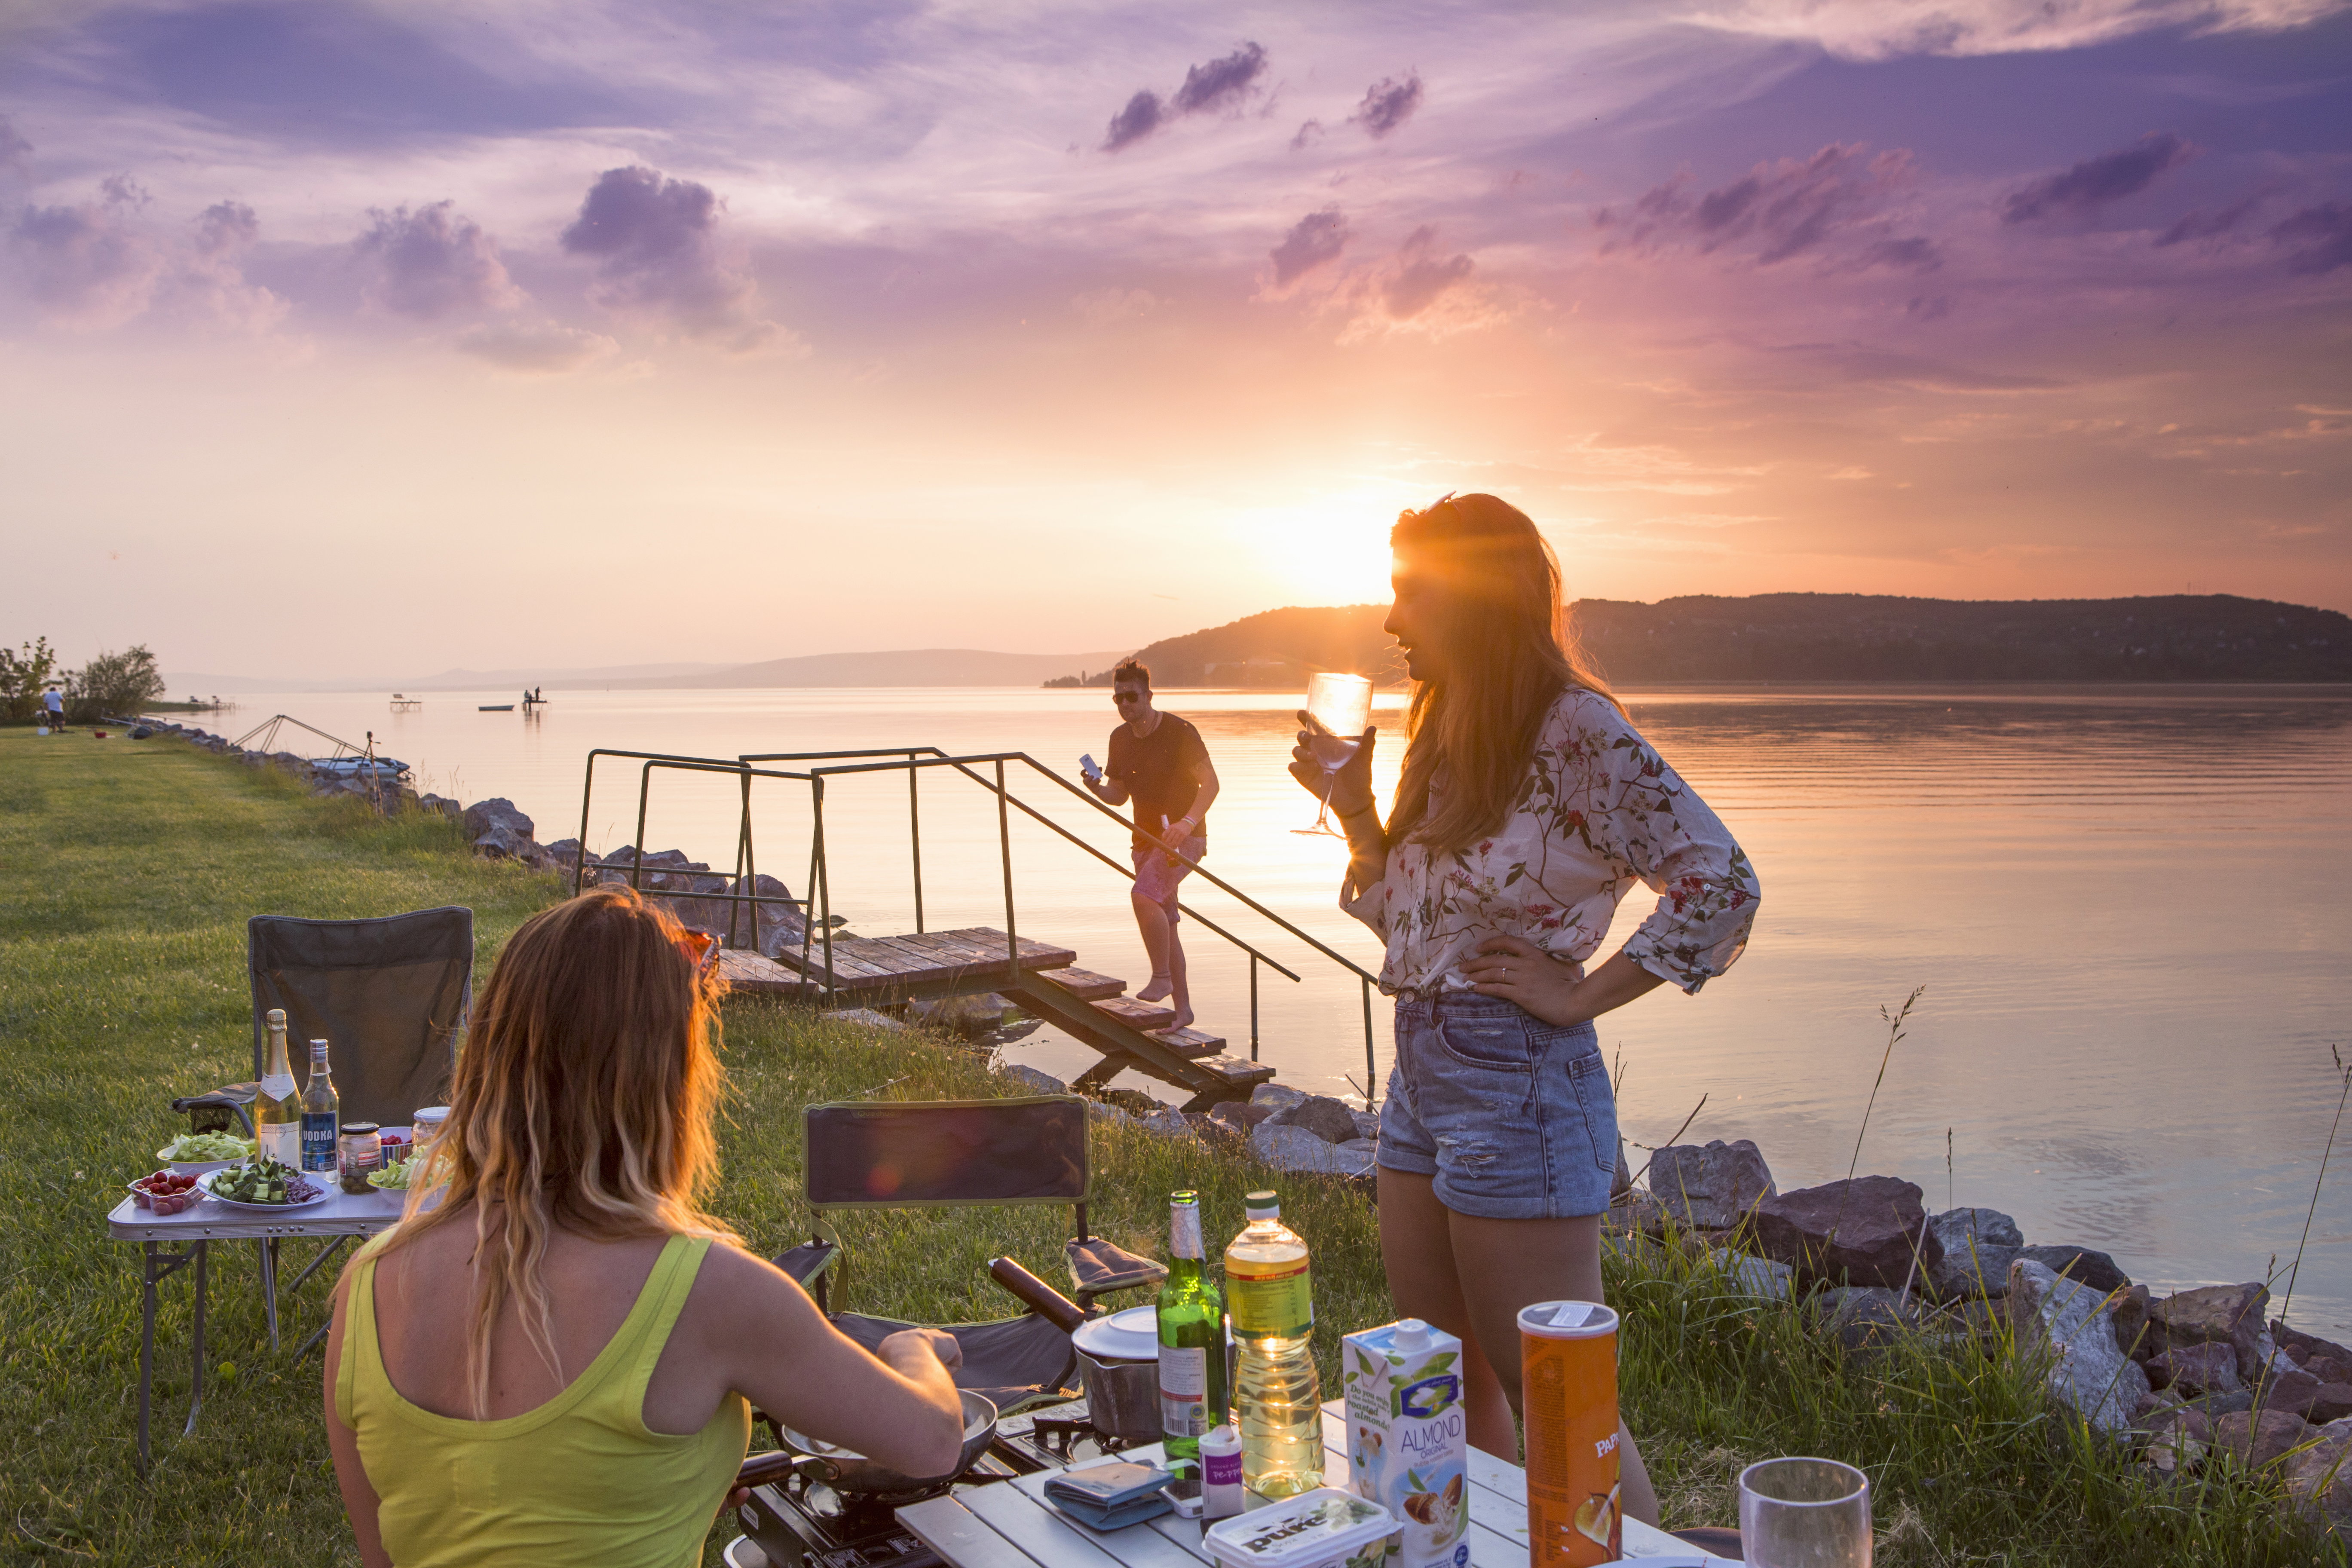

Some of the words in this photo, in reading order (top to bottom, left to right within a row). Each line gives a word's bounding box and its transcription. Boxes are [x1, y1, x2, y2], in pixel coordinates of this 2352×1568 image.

[303, 1130, 333, 1141] VODKA
[1351, 1384, 1361, 1394] Do
[1362, 1390, 1375, 1399] you
[1348, 1400, 1378, 1416] roasted
[1354, 1411, 1390, 1433] almonds?
[1401, 1415, 1461, 1453] ALMOND
[1421, 1442, 1448, 1459] ORIGINAL
[1241, 1515, 1328, 1553] pure
